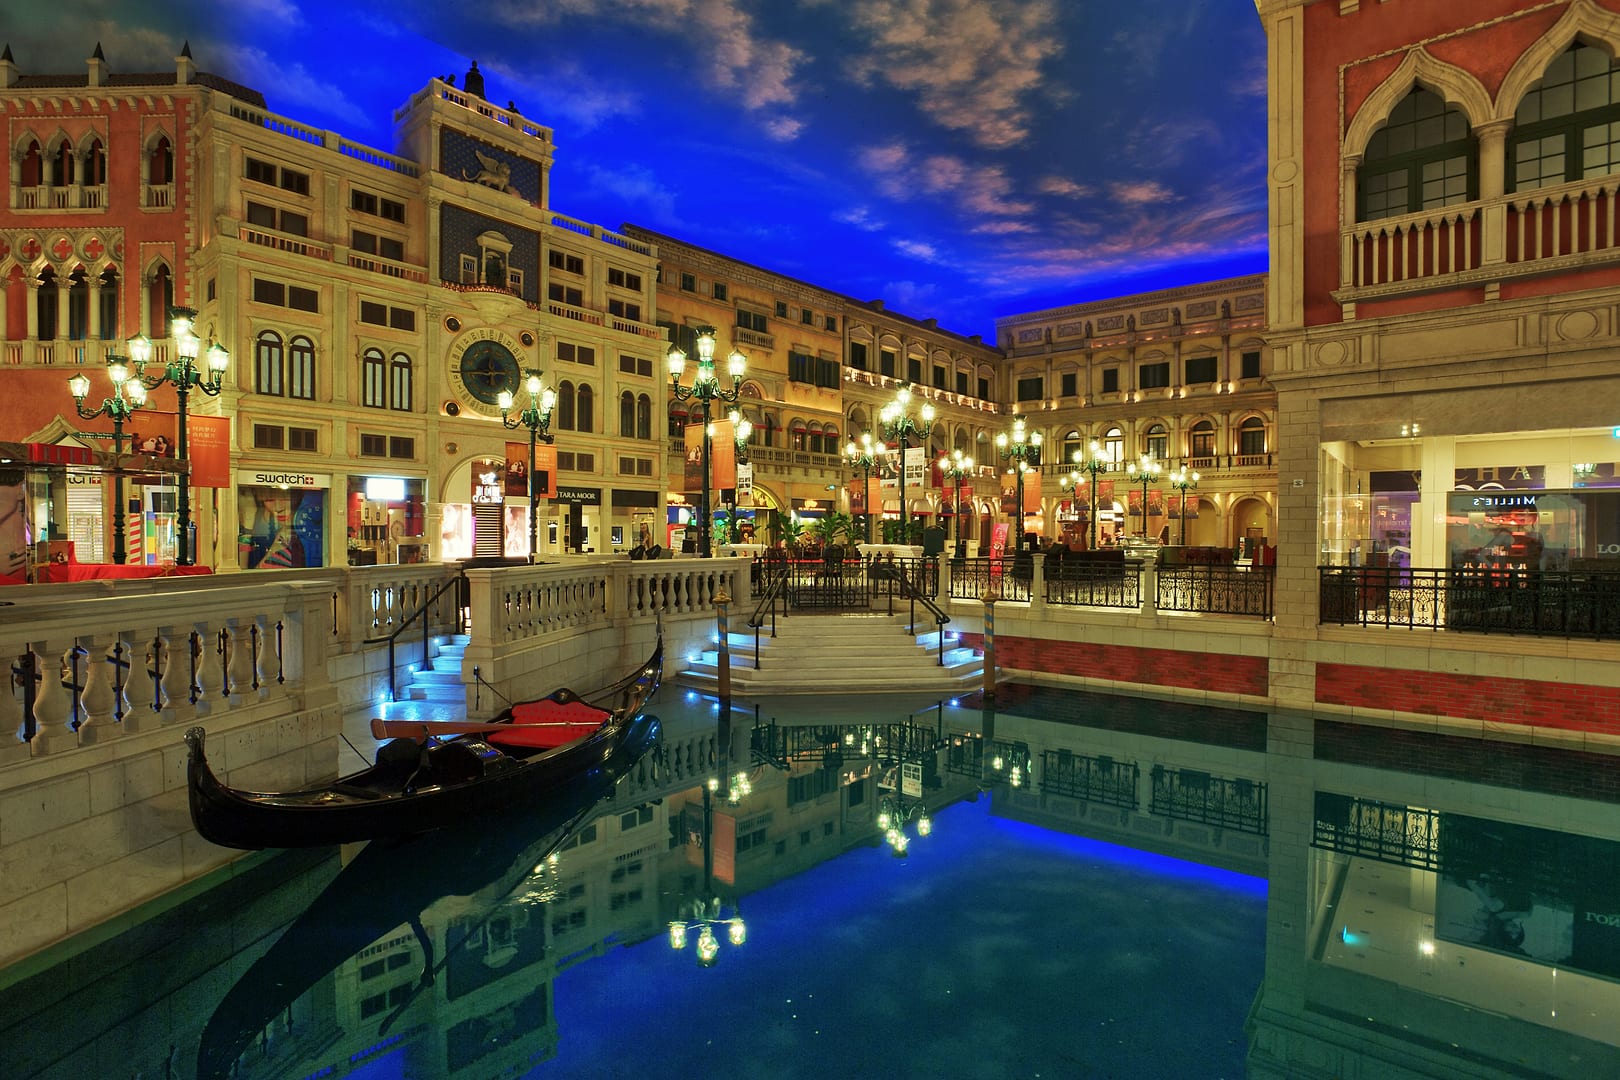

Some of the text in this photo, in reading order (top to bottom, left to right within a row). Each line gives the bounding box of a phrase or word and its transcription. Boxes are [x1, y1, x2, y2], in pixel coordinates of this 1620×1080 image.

[255, 473, 305, 485] swatch
[558, 491, 596, 500] TARA MOOR
